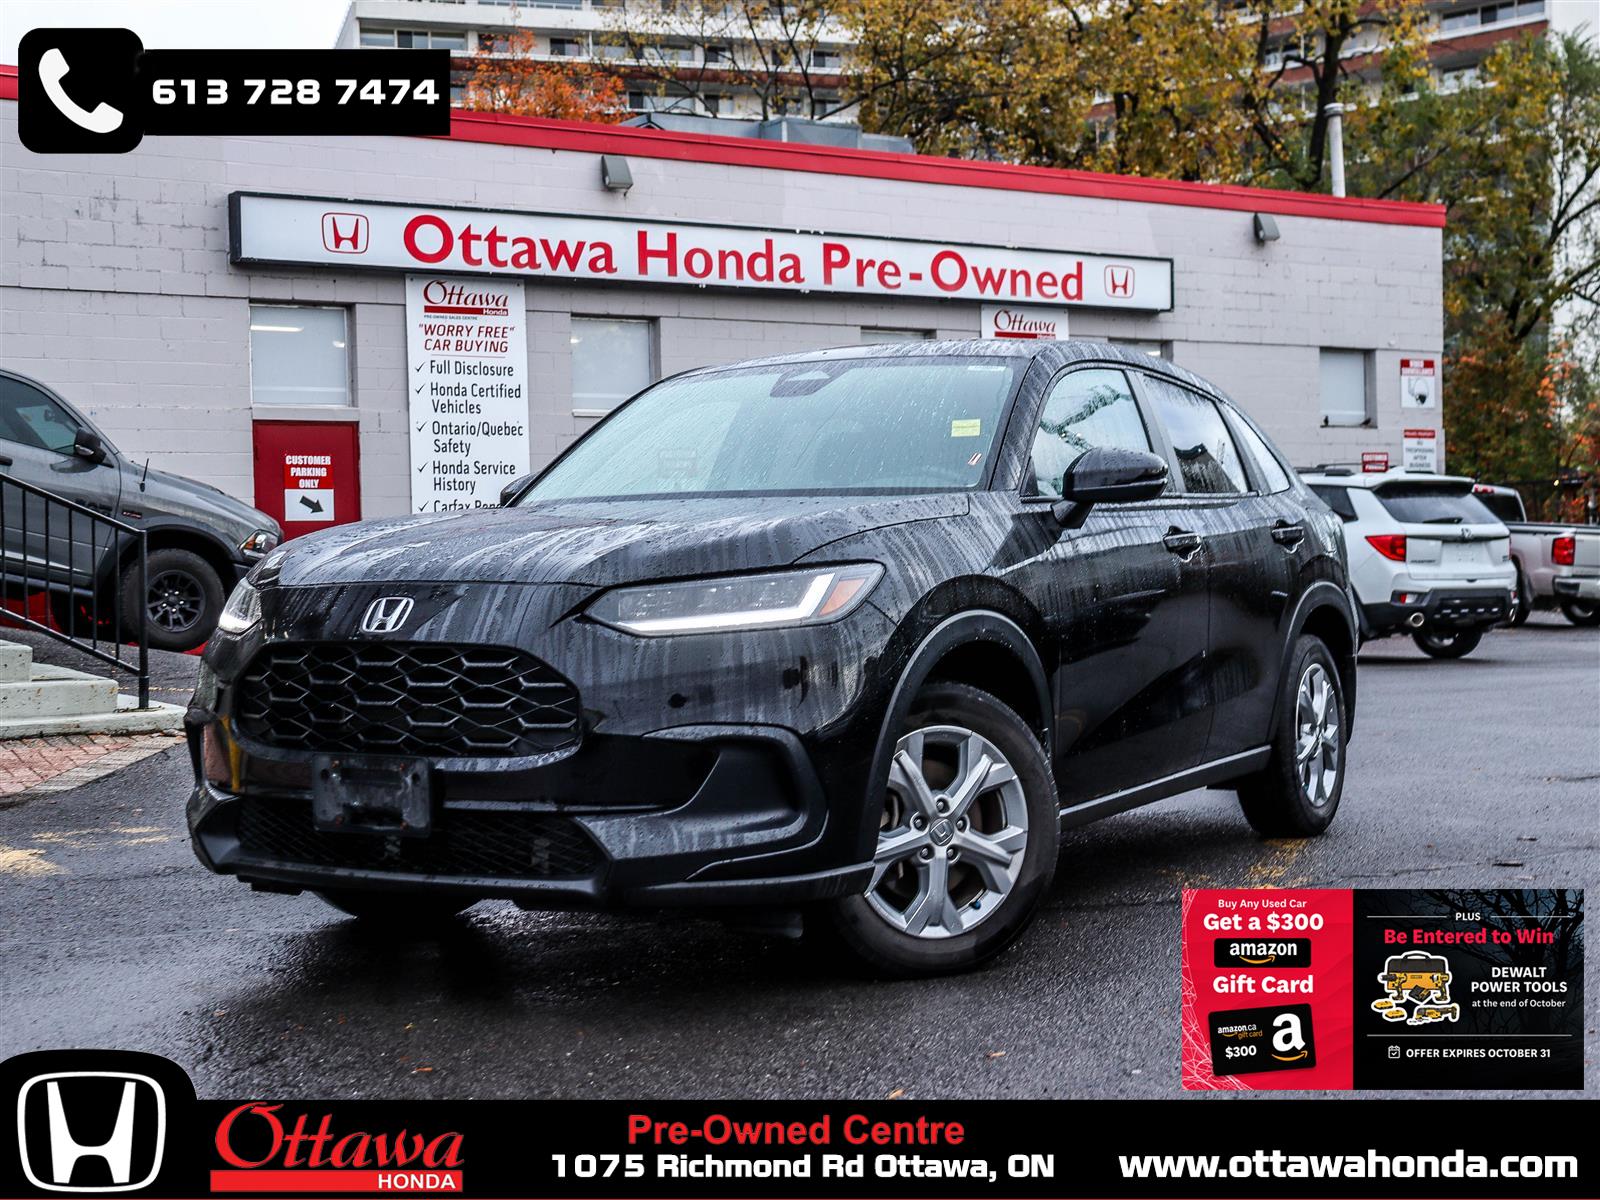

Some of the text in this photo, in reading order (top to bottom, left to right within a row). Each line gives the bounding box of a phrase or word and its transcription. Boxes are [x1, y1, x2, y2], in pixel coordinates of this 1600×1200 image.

[403, 214, 1083, 301] Ottawa Honda Pre-Owned
[423, 279, 508, 307] Ottawa
[482, 308, 508, 316] Honda
[994, 308, 1056, 332] Ottawa
[419, 323, 474, 337] "WORRY
[424, 338, 509, 353] CAR BUYING
[430, 359, 514, 376] Full Disclosure
[430, 381, 521, 398] Honda Certified
[432, 398, 482, 414] Vehicles
[432, 420, 524, 437] Ontario/Quebec
[433, 437, 471, 457] Safety
[285, 455, 331, 465] CUSTOMER
[432, 460, 516, 475] Honda Service
[290, 467, 328, 477] PARKING
[298, 478, 320, 489] ONLY
[433, 477, 476, 495] History
